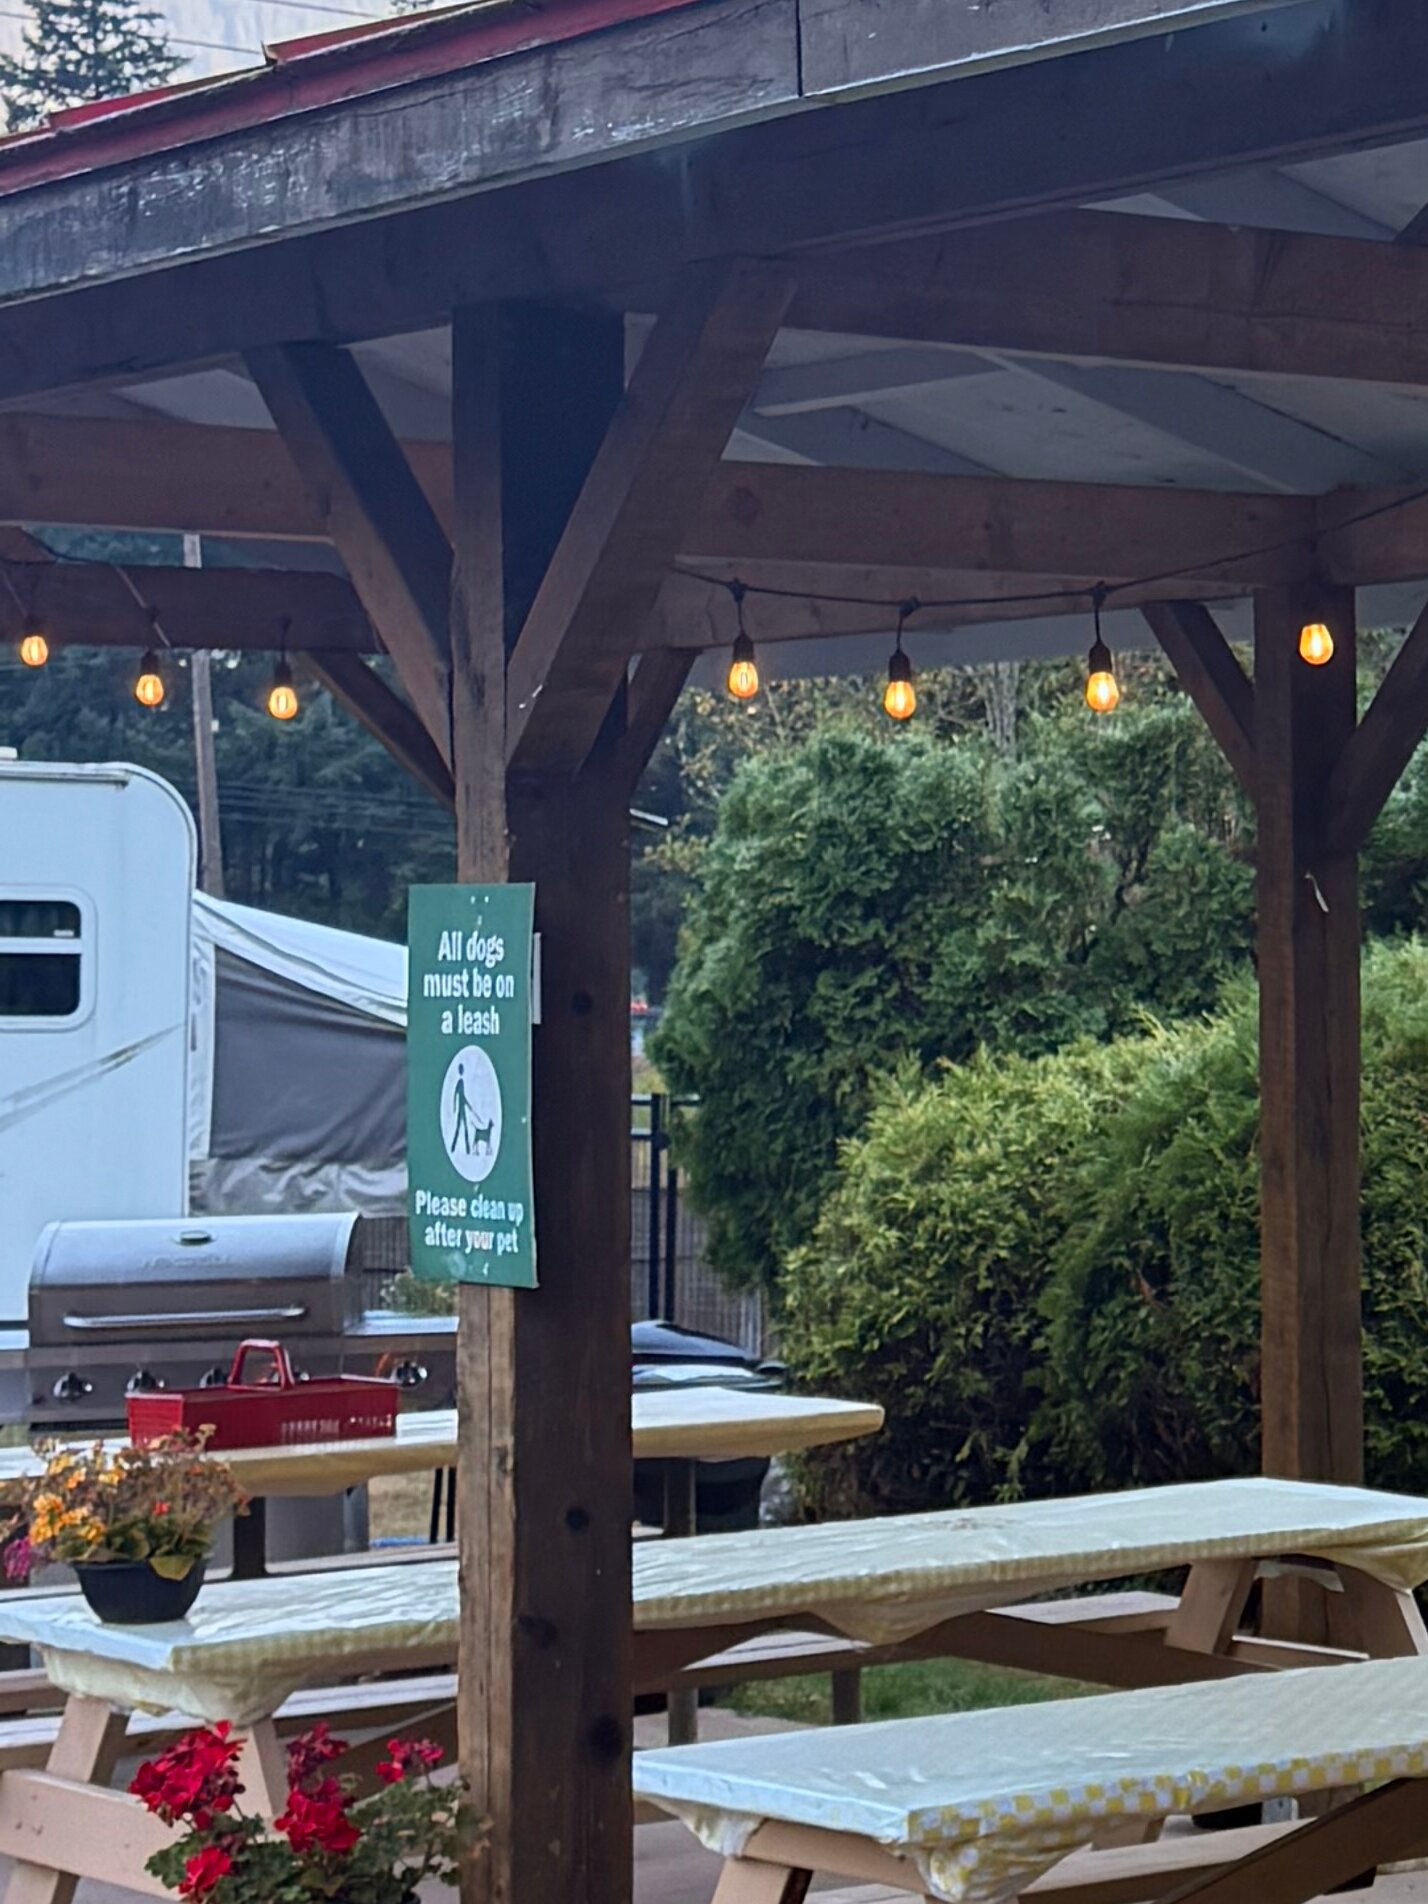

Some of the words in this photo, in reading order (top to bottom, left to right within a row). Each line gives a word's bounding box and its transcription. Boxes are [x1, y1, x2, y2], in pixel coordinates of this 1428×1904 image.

[438, 930, 462, 961] All
[466, 930, 504, 968] dogs
[423, 968, 469, 998] must
[472, 967, 492, 998] be
[496, 974, 515, 998] on
[441, 1010, 453, 1034] a
[458, 1004, 500, 1035] leash
[415, 1190, 467, 1217] Please
[470, 1193, 506, 1220] clean
[507, 1202, 524, 1227] up
[425, 1220, 462, 1247] after
[465, 1230, 494, 1254] your
[497, 1228, 519, 1256] pet
